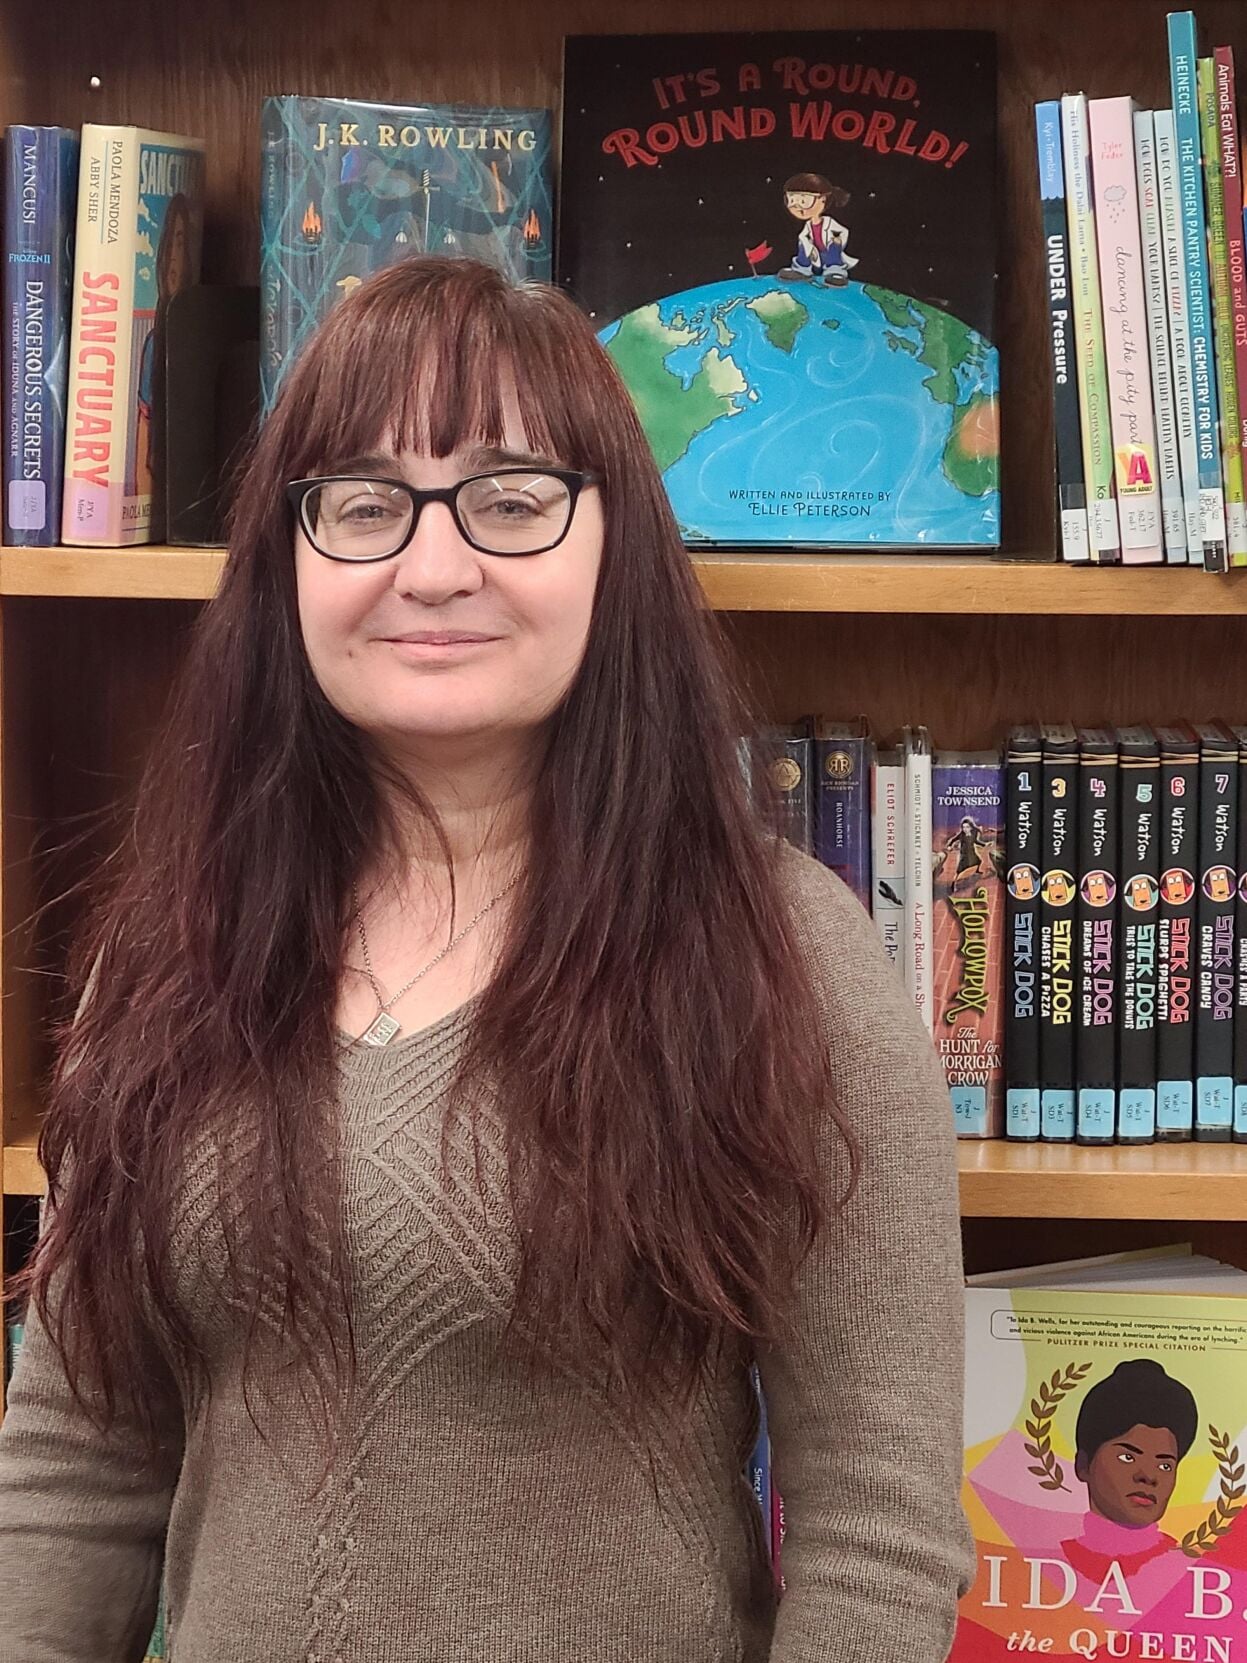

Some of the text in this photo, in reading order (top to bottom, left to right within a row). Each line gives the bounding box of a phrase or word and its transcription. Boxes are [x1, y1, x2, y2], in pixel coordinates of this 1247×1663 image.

[652, 56, 921, 109] IT'S A ROUND,
[313, 123, 537, 151] J.K. ROWLING
[602, 100, 970, 169] ROUND WORLD!
[1218, 65, 1237, 178] Animals Eat WHAT?!
[1045, 142, 1057, 183] Tremblay
[1071, 129, 1082, 170] Holiness
[22, 144, 38, 225] MANCUSI
[87, 156, 101, 223] ABBY SHER
[107, 140, 123, 244] PAOLA MENDOZA
[1074, 173, 1083, 188] the
[1076, 191, 1086, 216] Dalai
[1078, 219, 1088, 245] Lama
[9, 253, 51, 264] FROZEN II
[1176, 55, 1213, 459] HEINECKE THE KITCHEN PANTRY SCIENTIST: CHEMISTRY FOR KIDS
[1047, 235, 1068, 384] UNDER Pressure
[1229, 240, 1247, 346] BLOOD and GUTS
[12, 318, 20, 347] STORY
[24, 281, 45, 396] DANGEROUS
[1110, 246, 1141, 408] dancing at the pity
[11, 361, 19, 394] IDUNA
[72, 272, 120, 488] SANCTUARY
[1082, 309, 1102, 466] THE SEED OF COMPASSION
[10, 416, 19, 457] AGNARR
[23, 401, 42, 479] SECRETS
[729, 489, 892, 502] WRITTEN AND ILLUSTRATED BY
[748, 502, 871, 517] ELLIE PETERSON
[937, 796, 1001, 807] TOWNSEND
[946, 786, 992, 796] JESSICA
[1017, 772, 1032, 791] 1
[1051, 778, 1066, 797] 3
[1090, 778, 1106, 798] 4
[1136, 784, 1153, 803] 5
[1170, 777, 1186, 797] 6
[1215, 774, 1229, 794] 7
[836, 802, 844, 848] ROANHORSE
[887, 783, 895, 865] ELIOT SCHREFER
[1018, 801, 1033, 849] Watson
[1053, 808, 1067, 856] Watson
[1093, 808, 1108, 856] Watson
[1138, 813, 1152, 861] Watson
[1171, 807, 1186, 855] Watson
[1215, 804, 1230, 852] Watson
[913, 911, 926, 936] Long
[915, 902, 923, 910] A
[884, 921, 898, 941] The
[1041, 926, 1051, 968] CHASES
[1083, 920, 1092, 961] DREAMS
[915, 937, 926, 969] Road
[946, 886, 990, 1024] HOLLOWPOX
[1014, 912, 1035, 1018] STICK DOG
[1052, 919, 1073, 1024] STICK DOG
[1083, 961, 1092, 974] OF
[1093, 919, 1114, 1025] STICK DOG
[1158, 918, 1170, 1021] SLURPS SPAGHETTI
[1169, 917, 1191, 1024] STICK DOG
[1200, 925, 1213, 1009] CRAVES CANDY
[1213, 914, 1235, 1020] STICK DOG
[915, 974, 923, 983] on
[1041, 973, 1051, 981] A
[1124, 925, 1136, 1030] TRIES TO TAKE THE DONUTS
[1135, 923, 1156, 1030] STICK DOG
[1083, 994, 1092, 1027] CREAM
[940, 1039, 1000, 1054] HUNT for
[957, 1027, 977, 1039] The
[947, 1071, 989, 1088] CROW
[1047, 1338, 1207, 1352] PULITZER PRIZE SPECIAL CITATION
[1081, 1319, 1119, 1328] outstanding
[1133, 1322, 1170, 1331] courageous
[1171, 1323, 1201, 1332] reporting
[1224, 1326, 1247, 1334] horrific
[1098, 1330, 1120, 1338] African
[1156, 1333, 1177, 1341] during
[754, 1467, 763, 1492] Since
[982, 1555, 1247, 1621] IDA B.
[1006, 1628, 1234, 1663] the QUEEN
